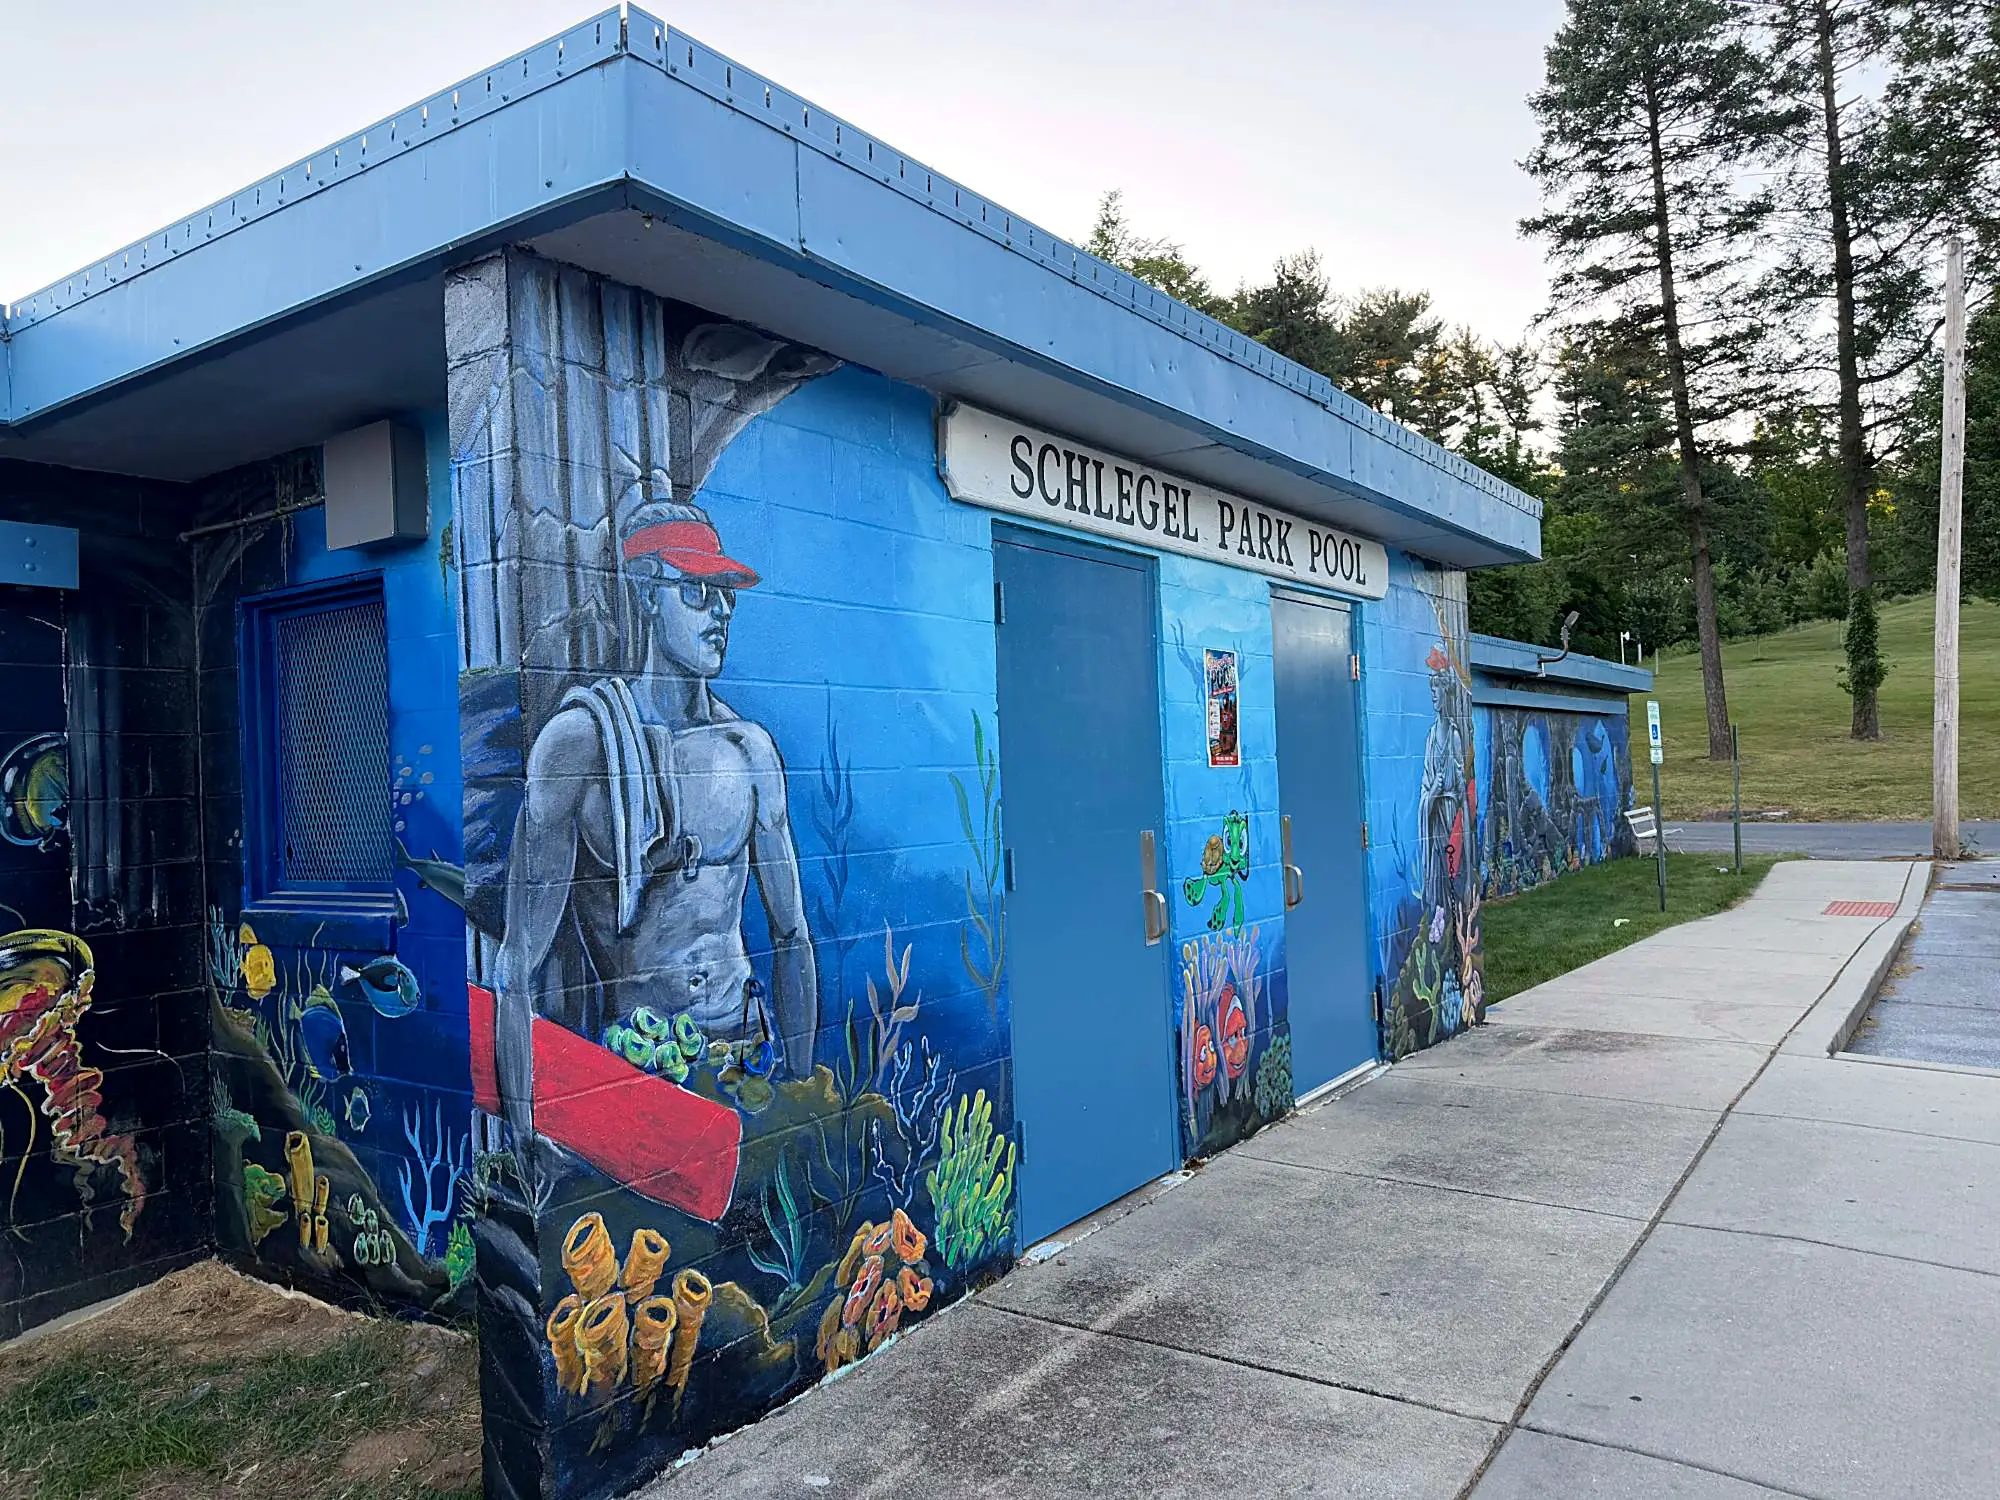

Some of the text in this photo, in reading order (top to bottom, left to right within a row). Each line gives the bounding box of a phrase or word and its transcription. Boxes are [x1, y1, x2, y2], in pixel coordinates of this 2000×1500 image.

[1010, 435, 1366, 585] SCHLEGEL PARK POOL
